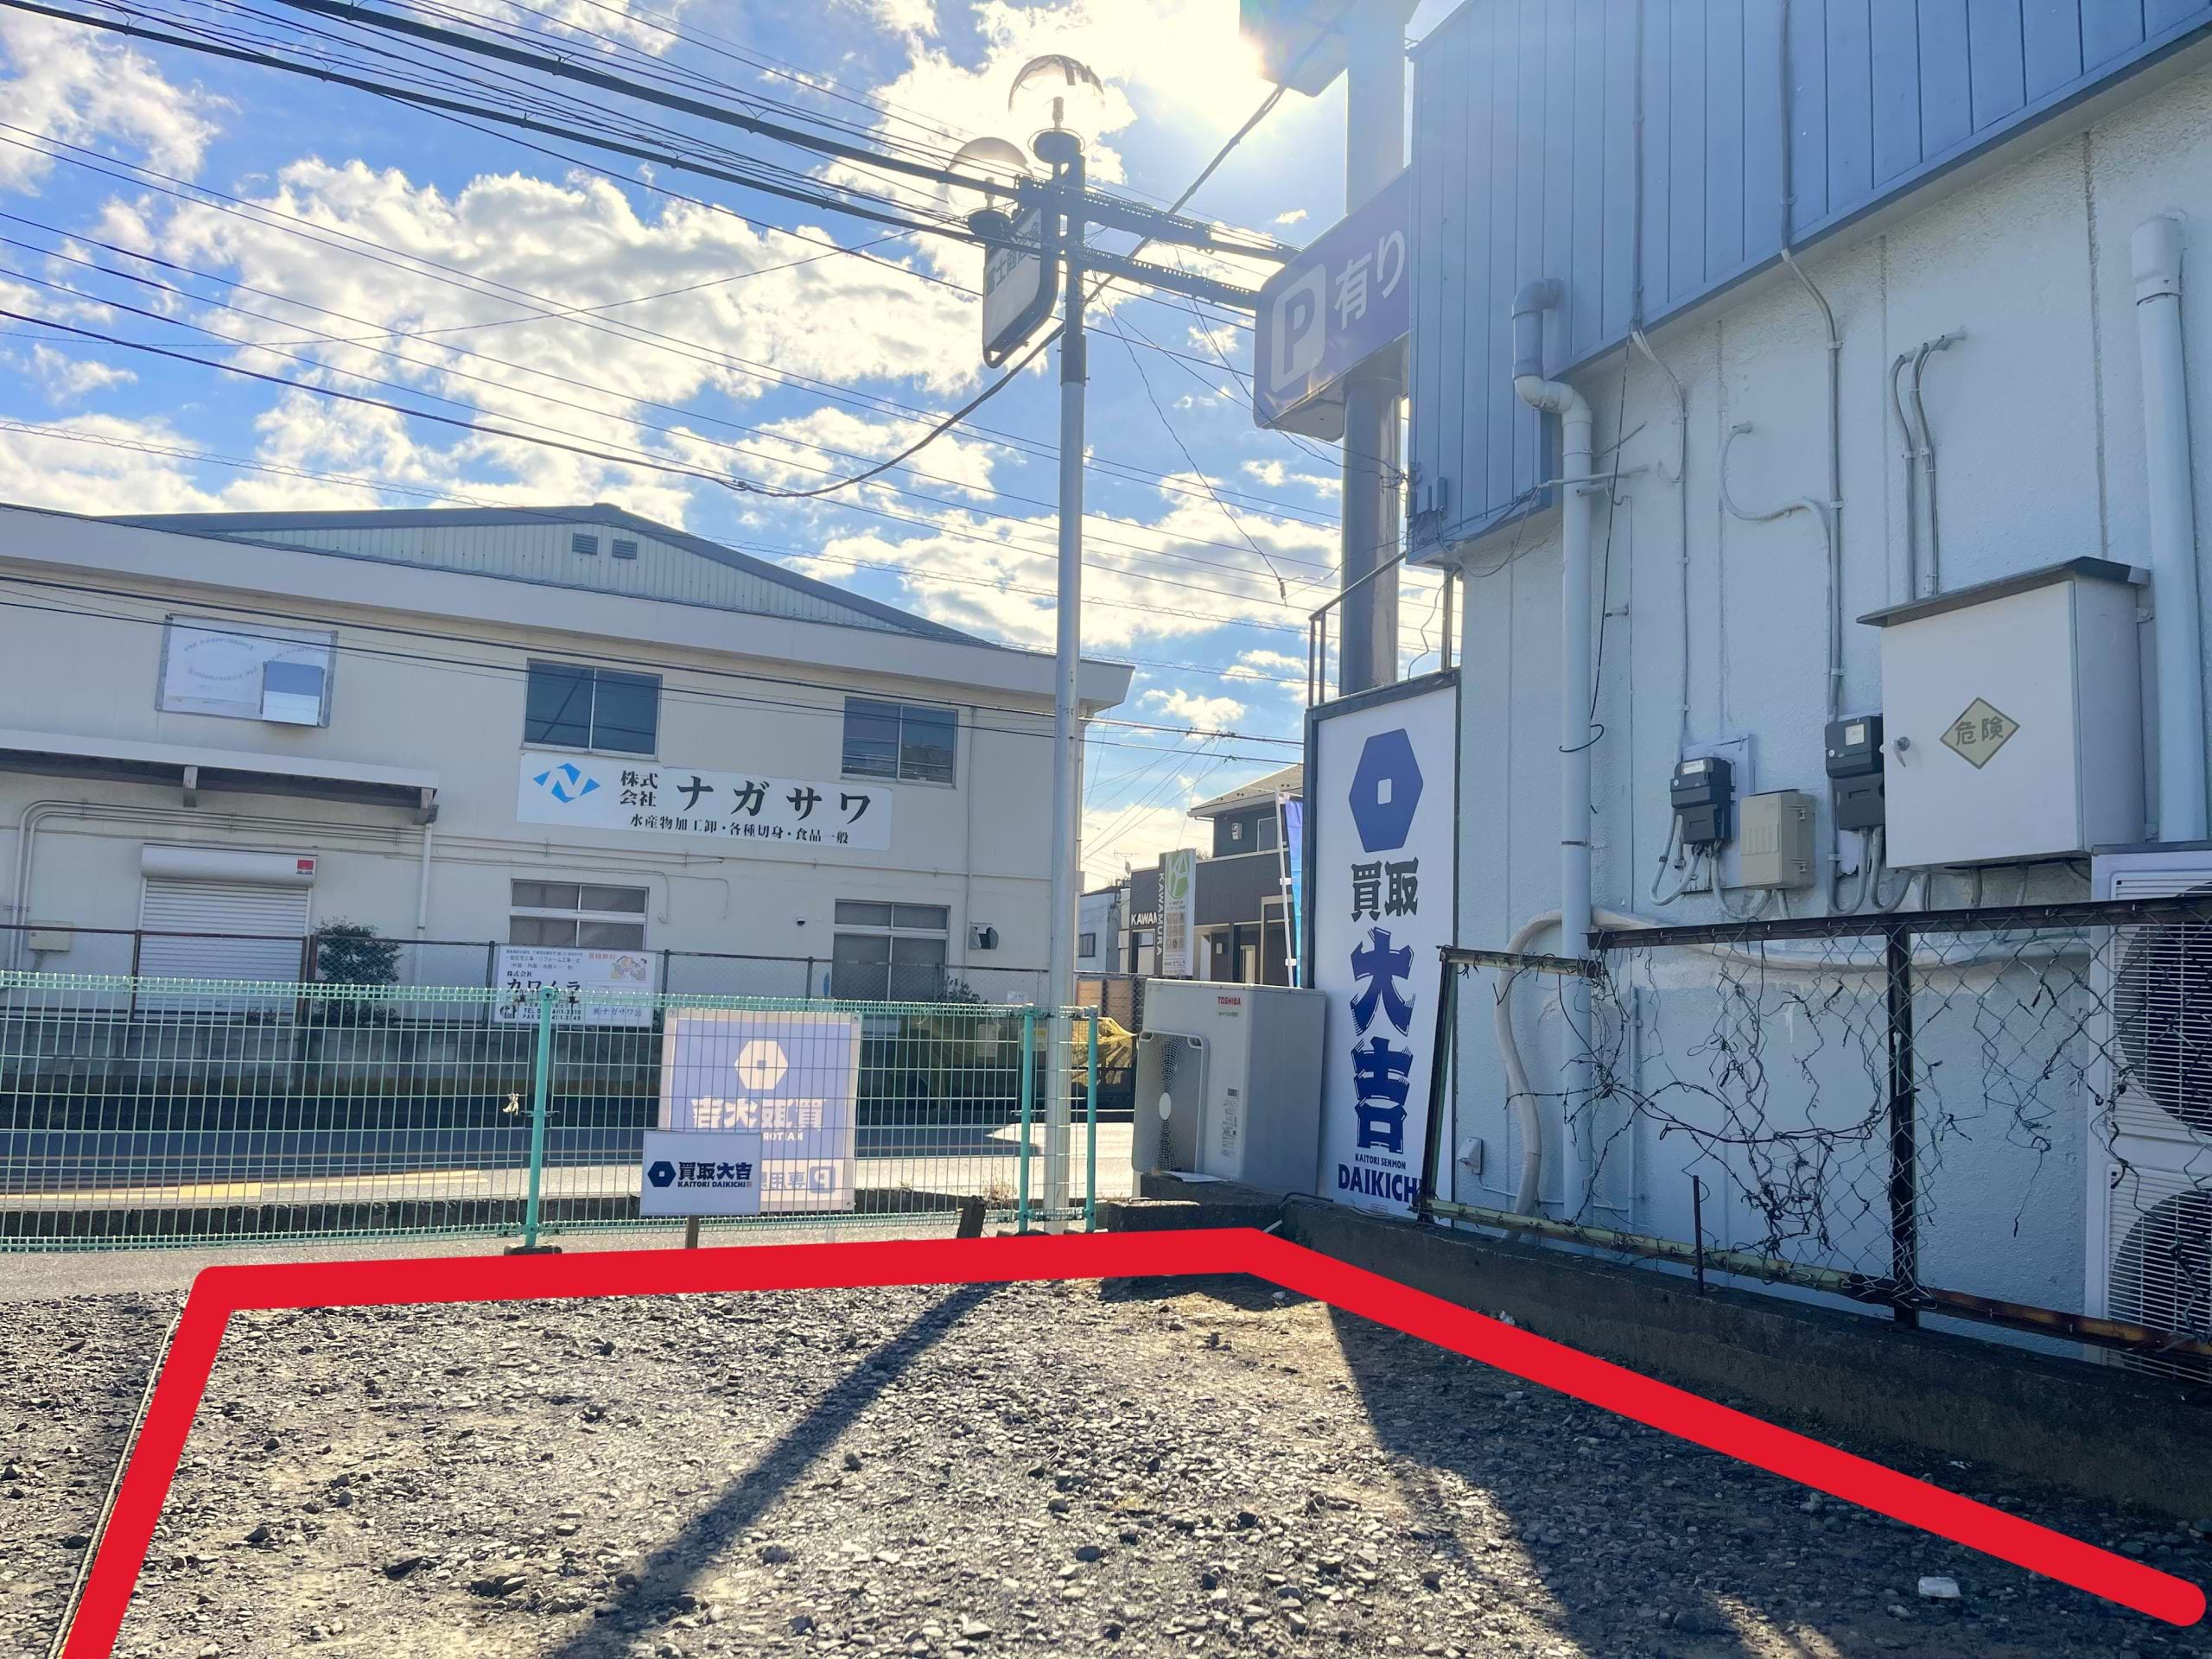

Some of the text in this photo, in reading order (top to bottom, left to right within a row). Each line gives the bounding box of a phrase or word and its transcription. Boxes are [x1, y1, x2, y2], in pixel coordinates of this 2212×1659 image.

[1334, 230, 1406, 330] 有り
[1955, 715, 2005, 746] 危険
[677, 775, 871, 824] ナガサワ
[1351, 856, 1419, 922] 買取
[1217, 996, 1241, 1006] TOSHIBA
[1350, 926, 1415, 1154] 大吉
[677, 1161, 753, 1180] 買取大吉
[1355, 1153, 1406, 1170] KAITORI SENMON
